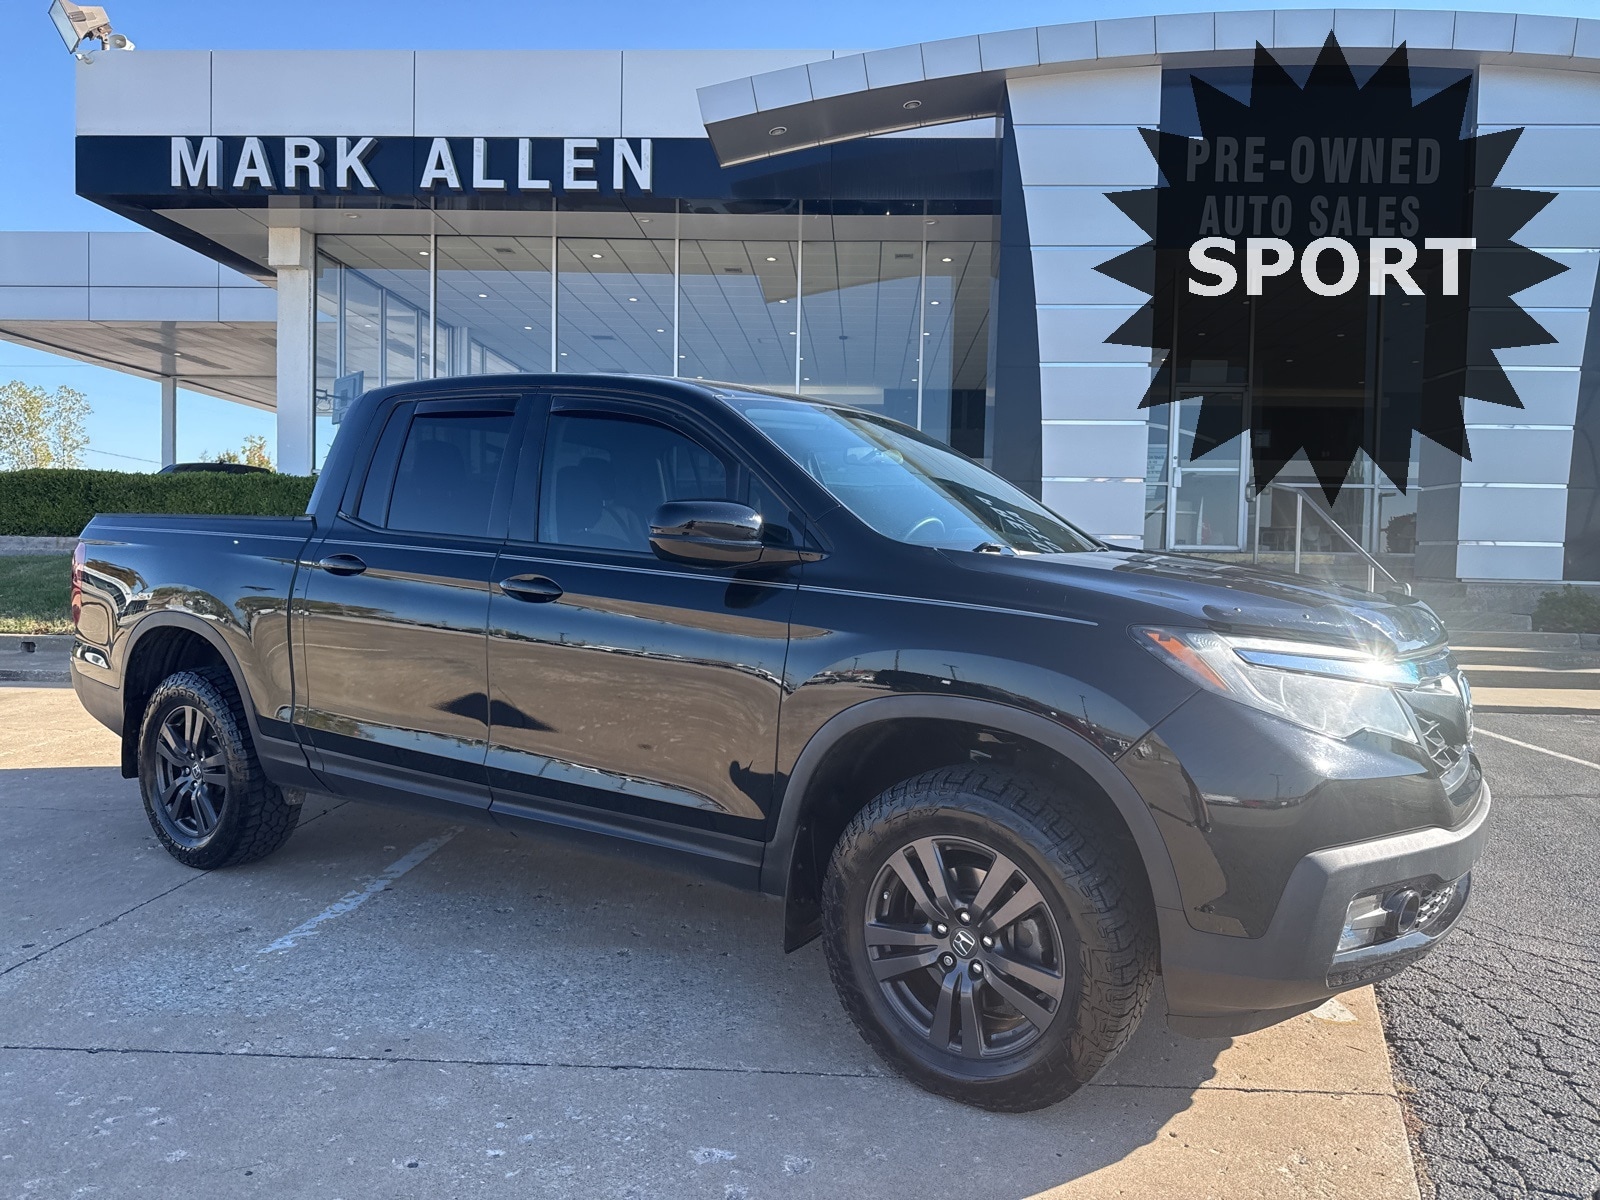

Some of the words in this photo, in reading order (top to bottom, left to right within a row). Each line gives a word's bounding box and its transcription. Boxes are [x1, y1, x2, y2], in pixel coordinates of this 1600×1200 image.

[170, 136, 379, 191] MARK
[419, 137, 653, 193] ALLEN
[1186, 136, 1441, 184] PRE-OWNED
[1199, 195, 1292, 236] AUTO
[1309, 195, 1420, 237] SALES
